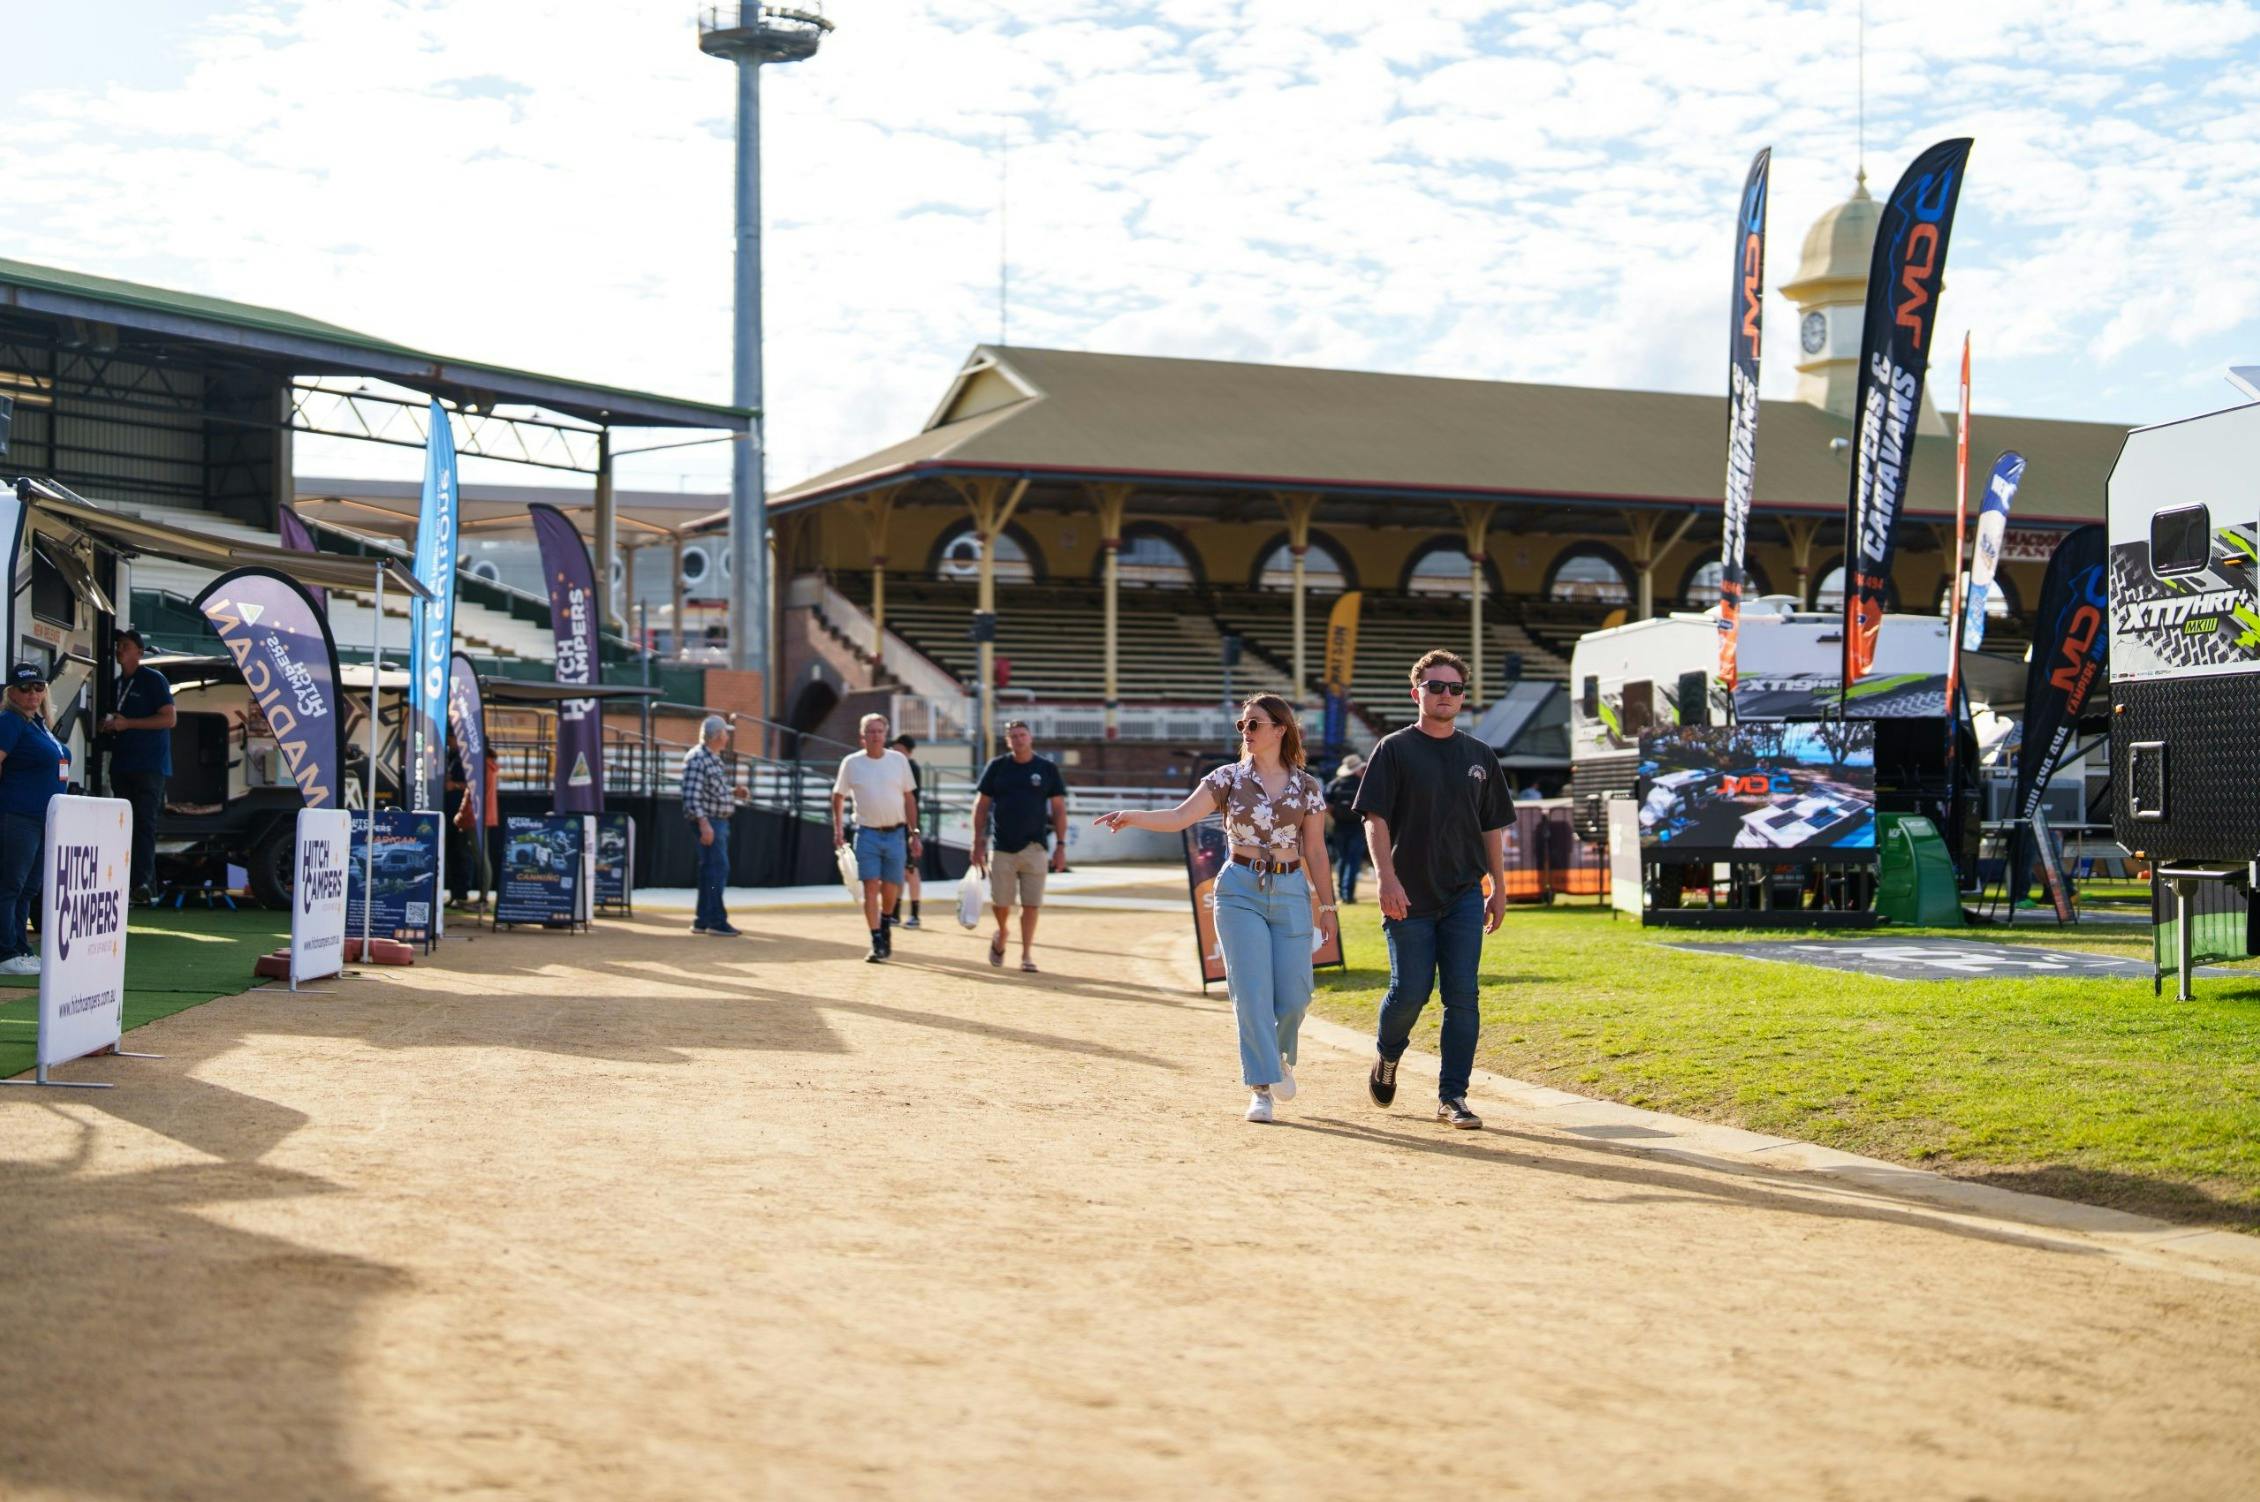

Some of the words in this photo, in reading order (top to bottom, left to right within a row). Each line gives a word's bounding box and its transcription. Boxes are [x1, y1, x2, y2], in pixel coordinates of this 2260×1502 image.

[1896, 167, 1954, 349] MDC
[1857, 386, 1885, 558] AMPERS
[1862, 366, 1917, 563] CARAVANS
[2050, 564, 2108, 692] MDC
[557, 640, 586, 720] HTCH
[1746, 679, 1840, 692] XT19HR
[2067, 659, 2096, 715] CAMPERS
[1716, 774, 1793, 795] MDC
[55, 845, 98, 911] HITCH
[303, 840, 329, 882] HITCH
[304, 869, 342, 914] CAMPERS
[58, 889, 119, 961] CAMPERS
[58, 988, 116, 1019] www.hitchcampers.com.au
